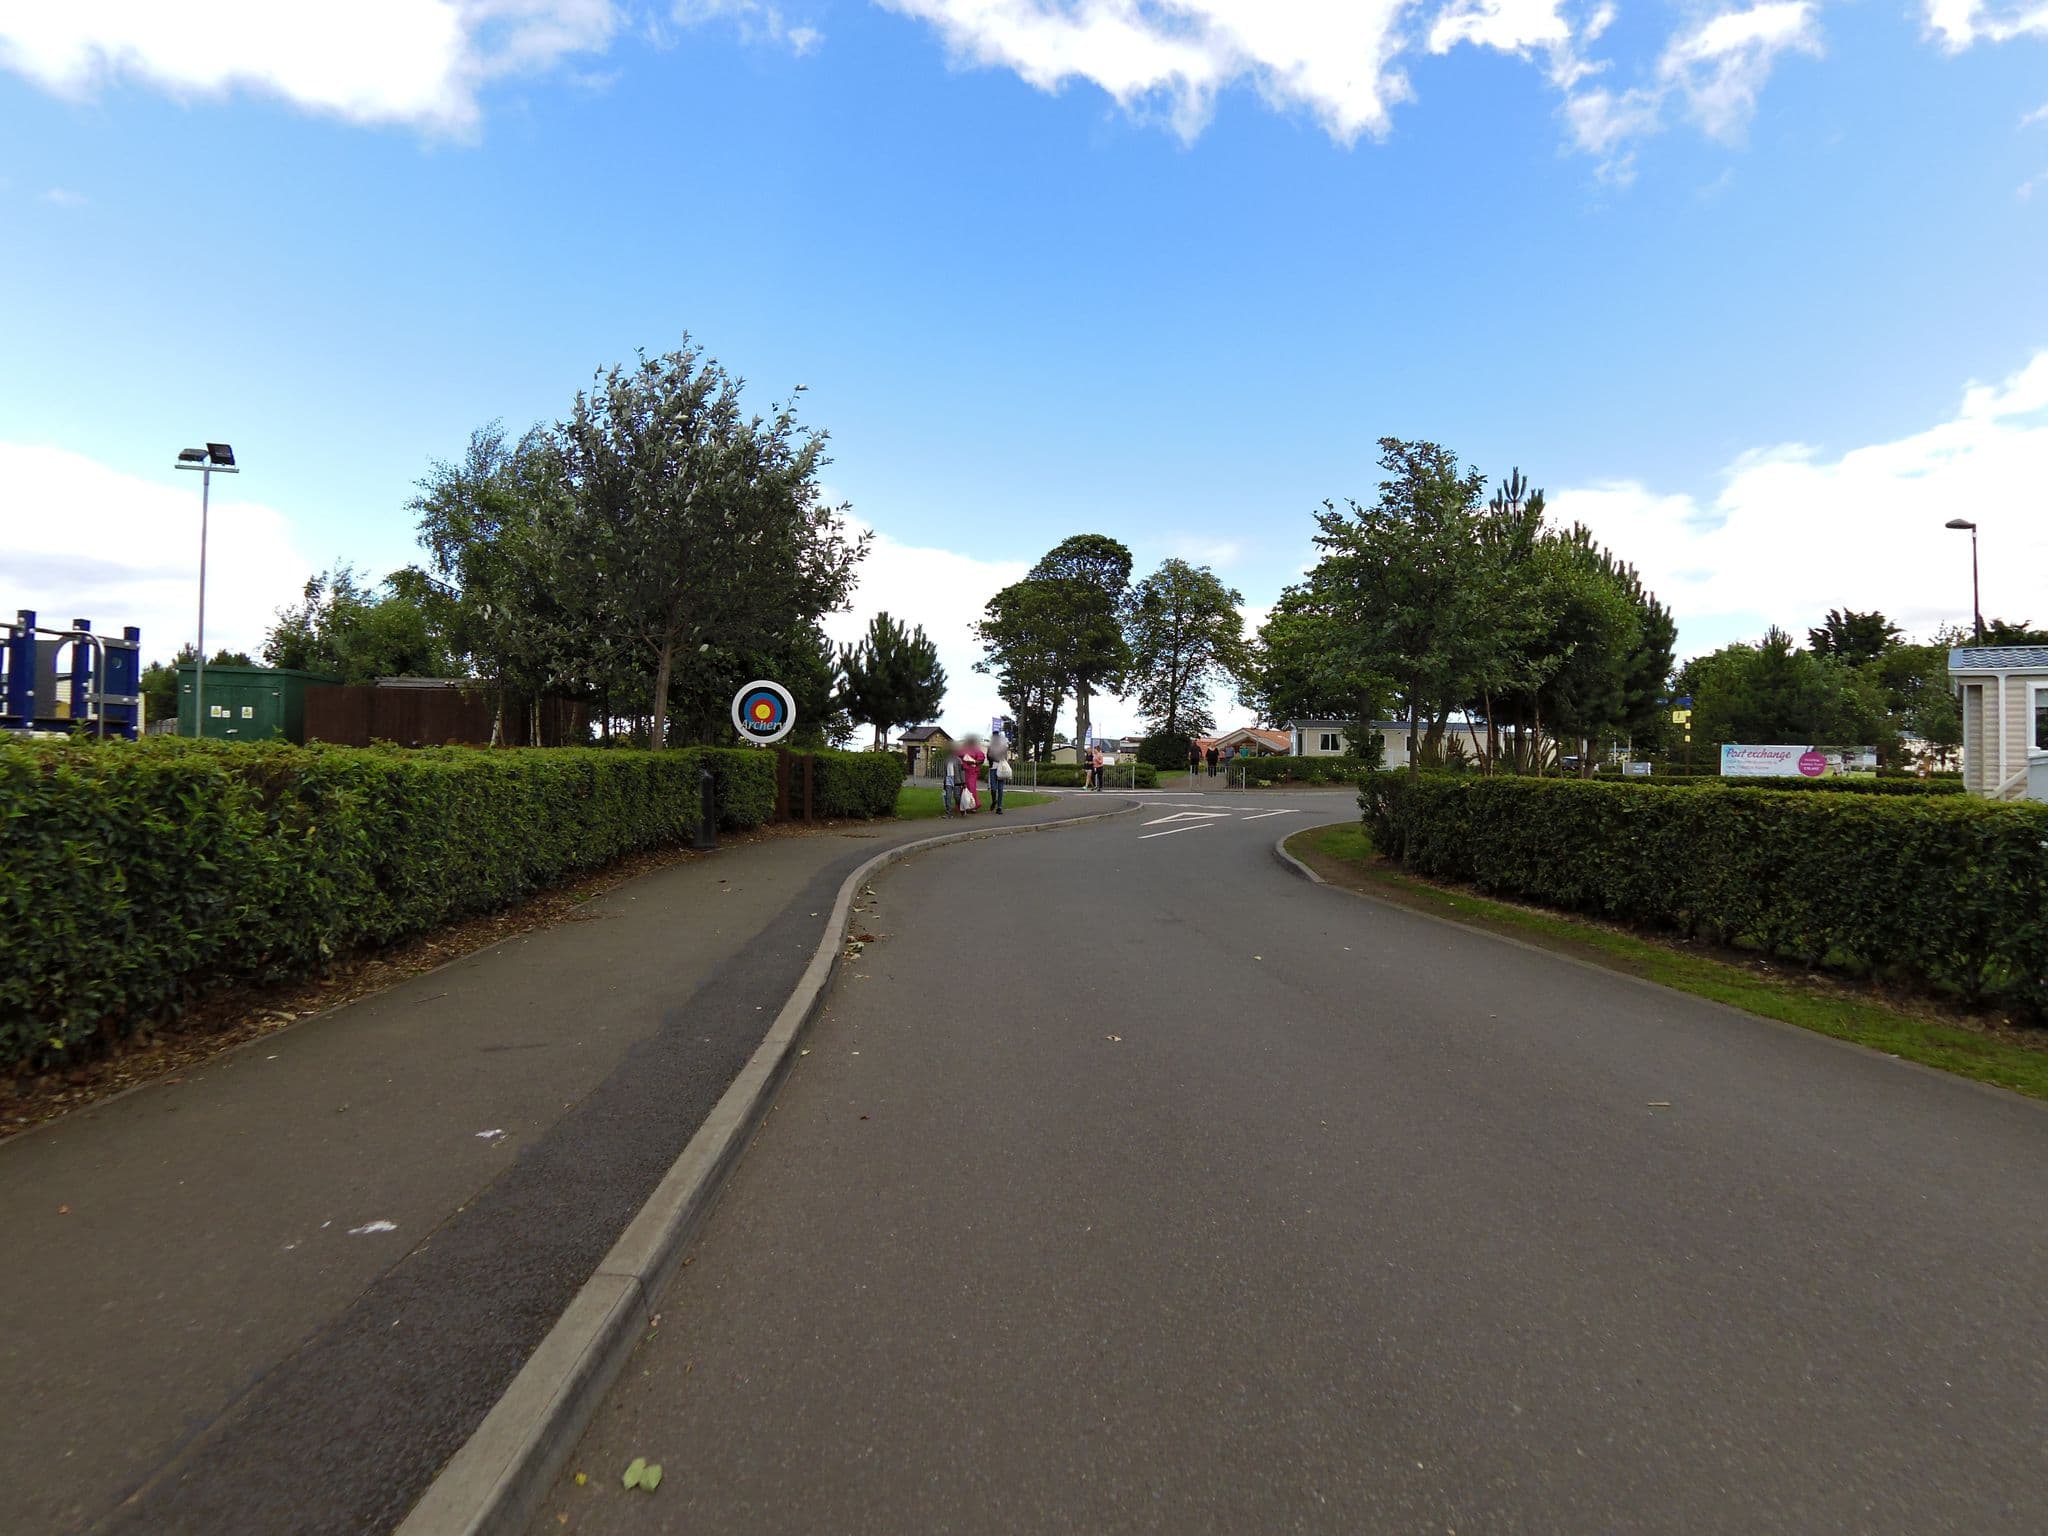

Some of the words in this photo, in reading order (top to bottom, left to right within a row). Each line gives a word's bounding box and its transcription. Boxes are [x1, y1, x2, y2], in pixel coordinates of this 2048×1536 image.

[741, 719, 786, 732] Archery
[1726, 747, 1747, 758] Part
[1747, 748, 1792, 762] exchange
